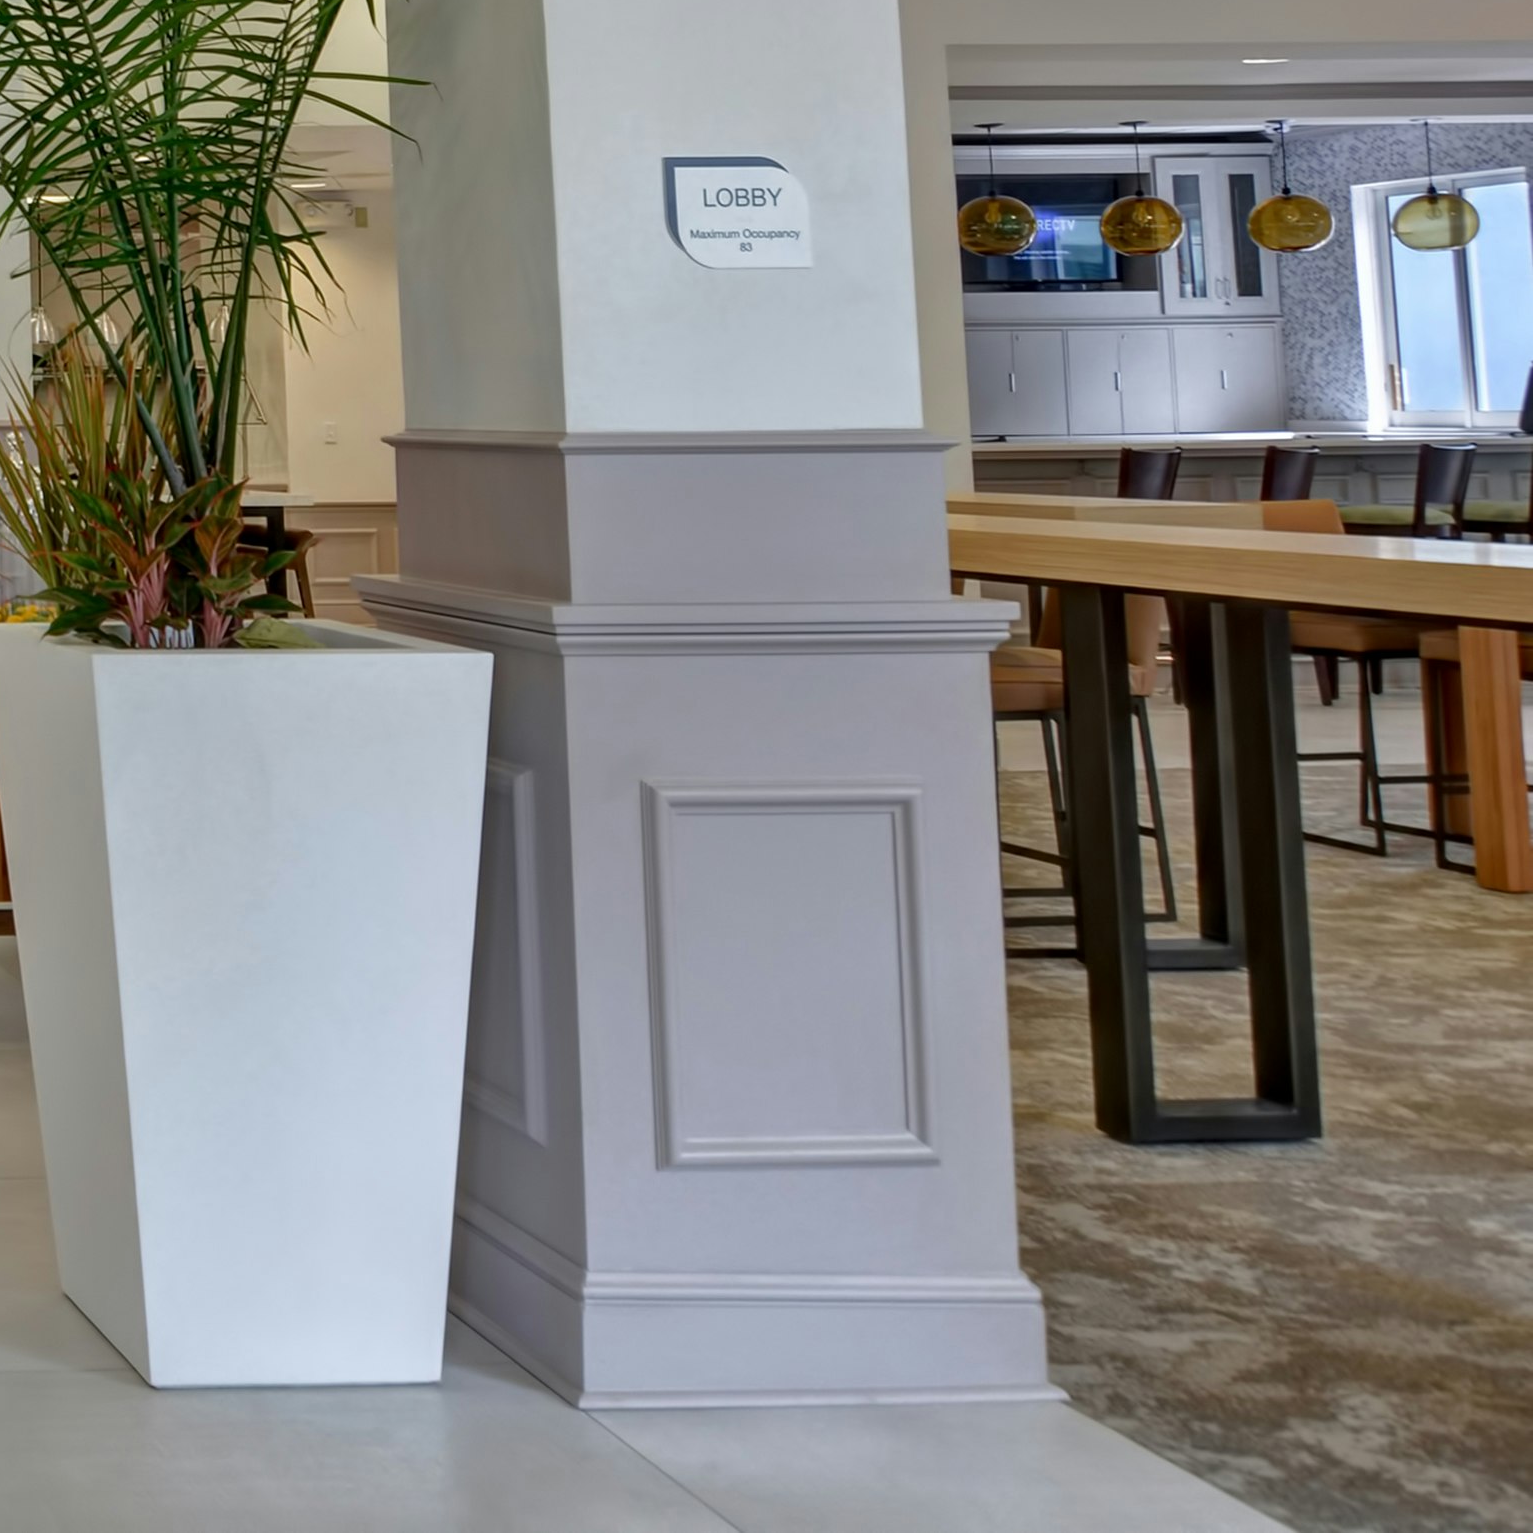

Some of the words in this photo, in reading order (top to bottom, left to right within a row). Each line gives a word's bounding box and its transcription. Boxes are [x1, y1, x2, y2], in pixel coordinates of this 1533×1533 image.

[702, 187, 782, 208] LOBBY
[1036, 218, 1075, 231] RECTV
[690, 229, 740, 239] Maximum
[742, 228, 800, 240] Occupancy
[739, 242, 753, 252] 83
